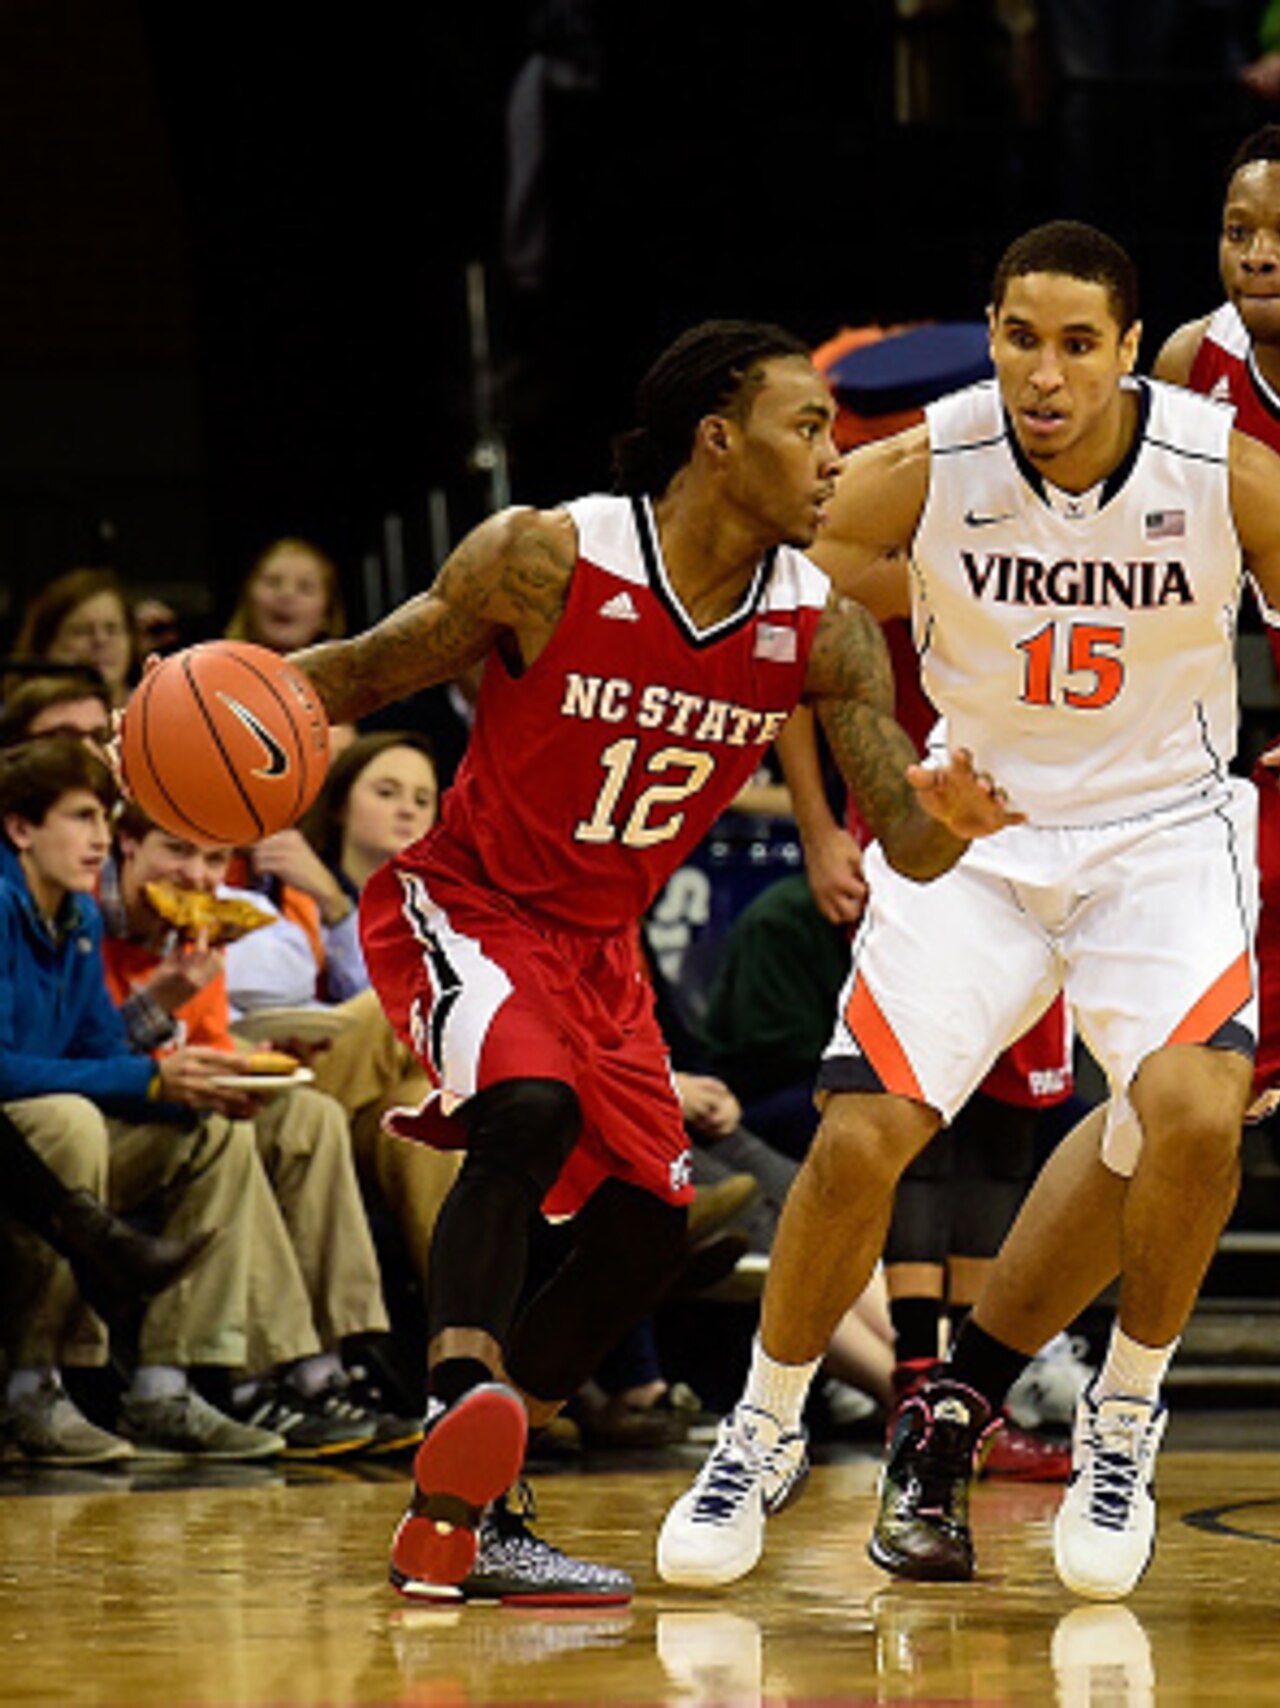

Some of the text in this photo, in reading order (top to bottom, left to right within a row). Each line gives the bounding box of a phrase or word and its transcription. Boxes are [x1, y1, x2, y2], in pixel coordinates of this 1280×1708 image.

[960, 548, 1198, 610] VIRGINIA
[1015, 618, 1126, 710] 15
[560, 672, 789, 747] NC STATE
[573, 736, 717, 850] 12
